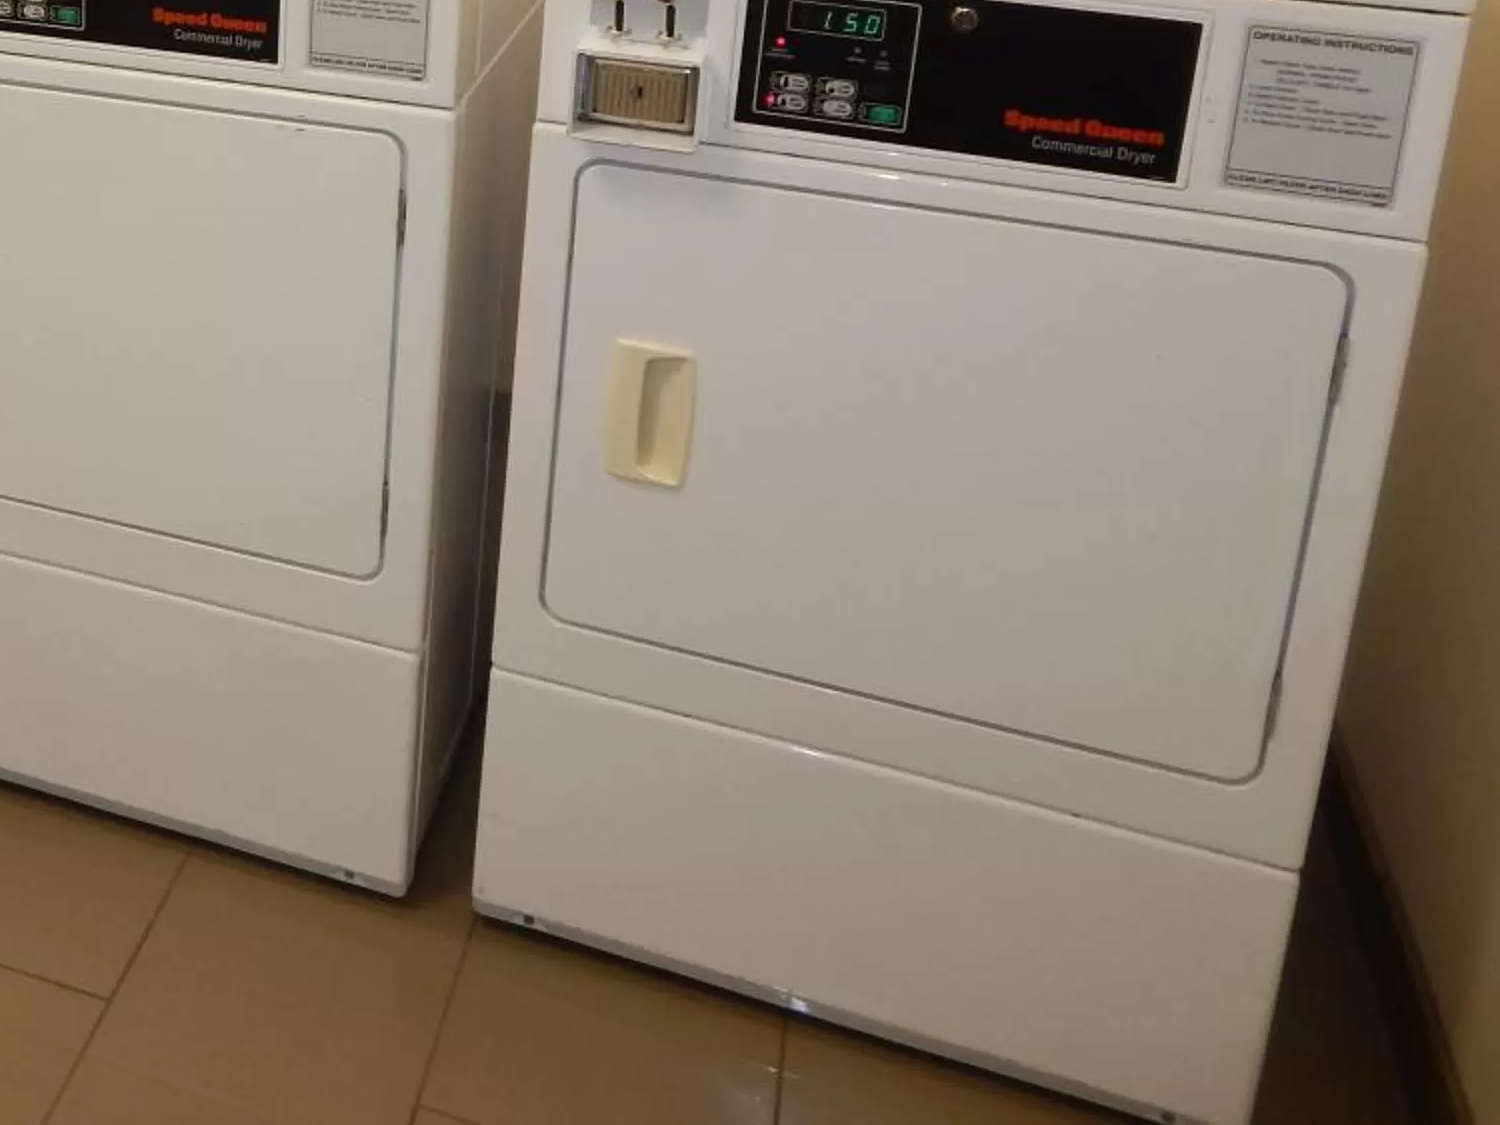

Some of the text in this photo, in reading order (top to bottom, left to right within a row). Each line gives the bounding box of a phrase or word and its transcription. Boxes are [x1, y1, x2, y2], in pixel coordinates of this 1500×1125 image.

[152, 7, 267, 34] Speed Queen
[173, 28, 263, 51] Commercial Dryer
[1252, 30, 1415, 56] OPERATING INSTRUCTIONS
[1004, 108, 1166, 148] Speed Queen
[1030, 134, 1157, 166] Commercial Dryer
